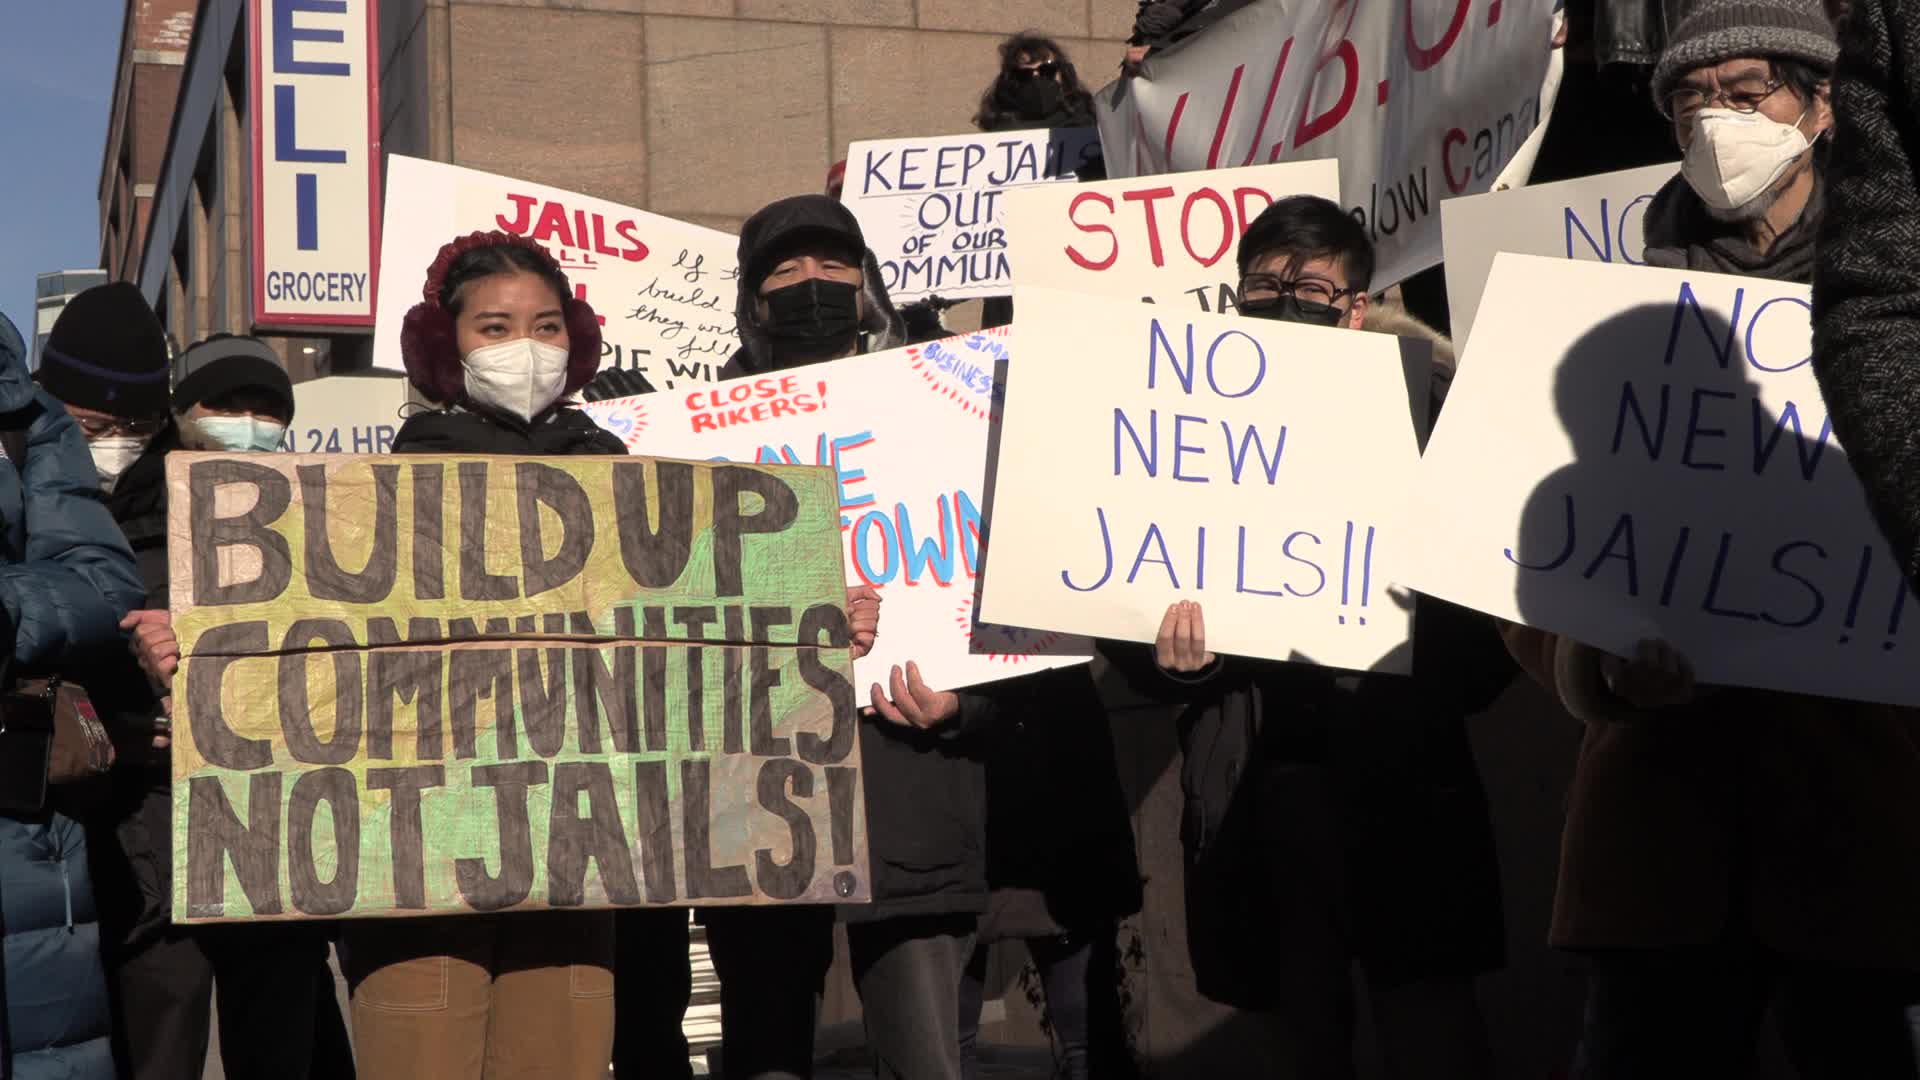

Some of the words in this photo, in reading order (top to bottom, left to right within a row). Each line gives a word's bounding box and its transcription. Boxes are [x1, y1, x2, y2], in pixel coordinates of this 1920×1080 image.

[863, 143, 986, 194] KEEP
[495, 193, 650, 262] JAILS
[902, 233, 937, 255] OF
[952, 228, 1008, 250] OUR
[918, 189, 1003, 230] OUT
[267, 271, 367, 303] GROCERY
[625, 305, 689, 339] they
[1663, 281, 1813, 372] NO
[1148, 318, 1266, 398] NO
[686, 375, 800, 411] CLOSE
[691, 381, 826, 433] RIKERS!
[307, 427, 342, 452] 24
[1114, 407, 1287, 485] NEW
[1610, 379, 1833, 481] NEW
[188, 458, 596, 607] BUILD
[612, 459, 800, 598] UP
[1061, 507, 1375, 626] JAILS!!
[185, 602, 857, 771] COMMUNITIES
[185, 764, 446, 918] NOT
[454, 758, 859, 903] JAILS!
